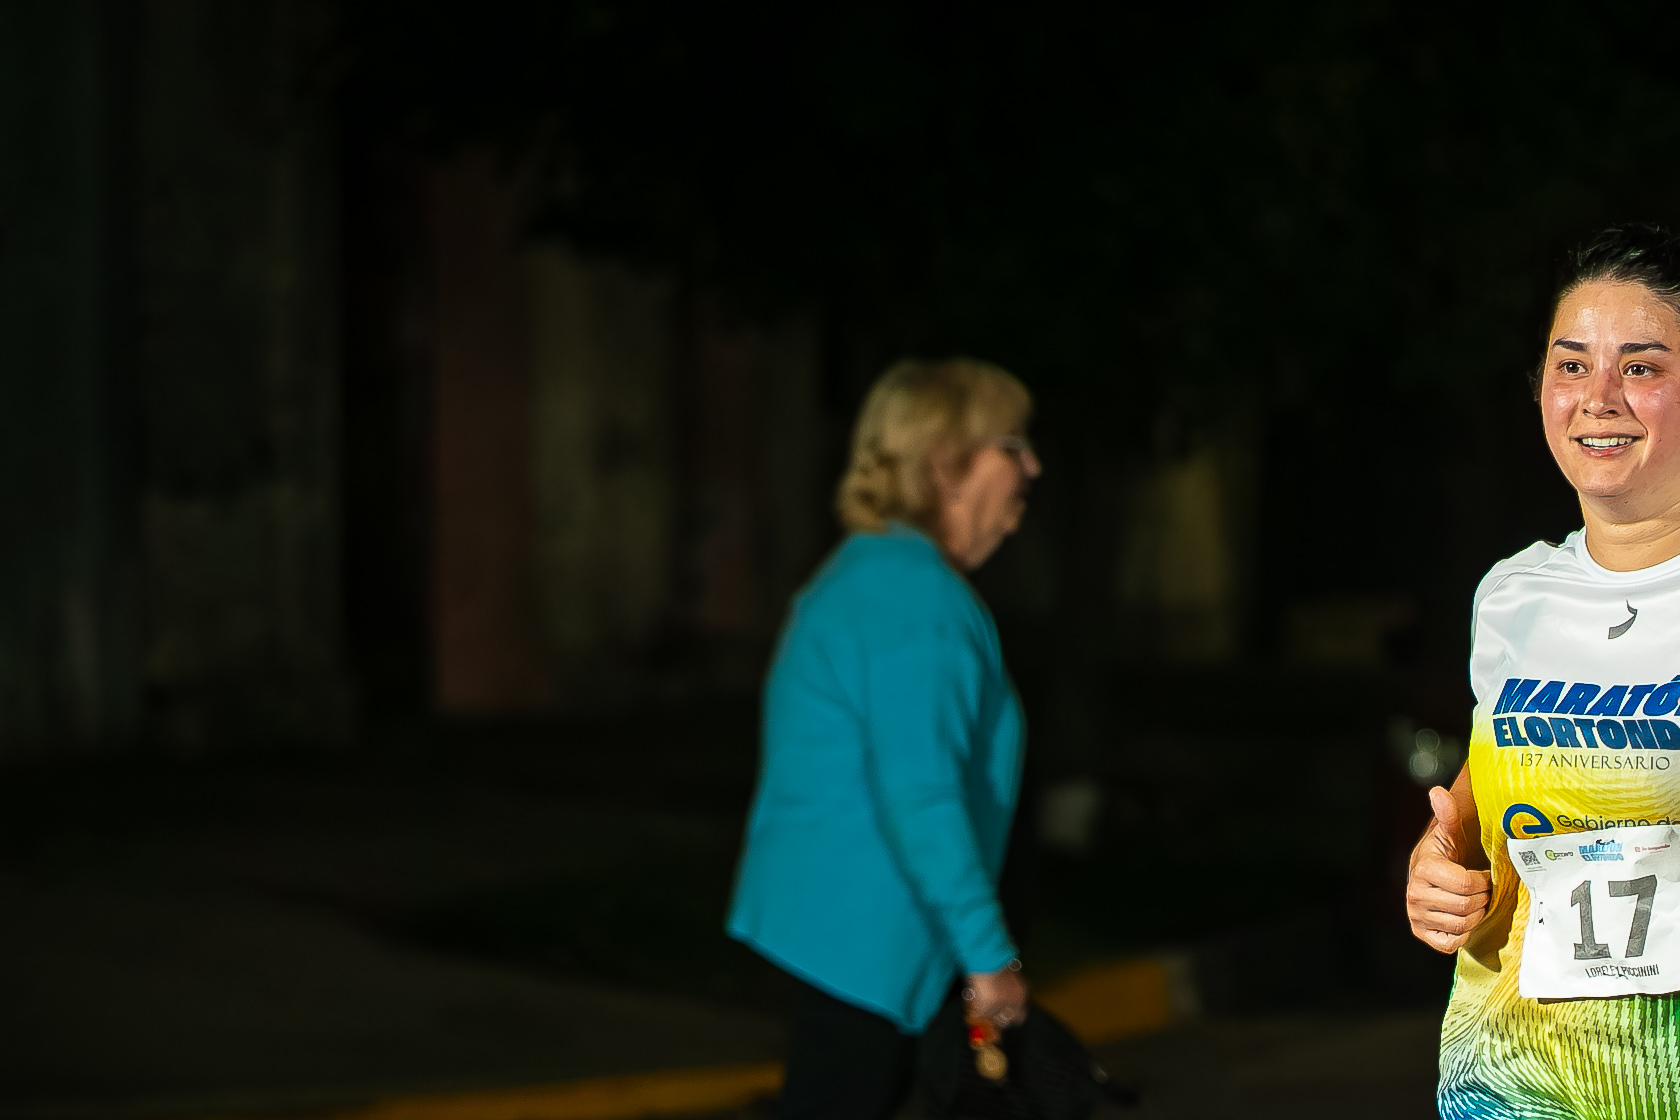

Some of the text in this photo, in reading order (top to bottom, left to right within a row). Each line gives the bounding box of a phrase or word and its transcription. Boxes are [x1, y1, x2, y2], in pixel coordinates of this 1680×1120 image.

[1520, 753, 1671, 771] 137 ANIVERSARIO
[1570, 874, 1658, 960] 17
